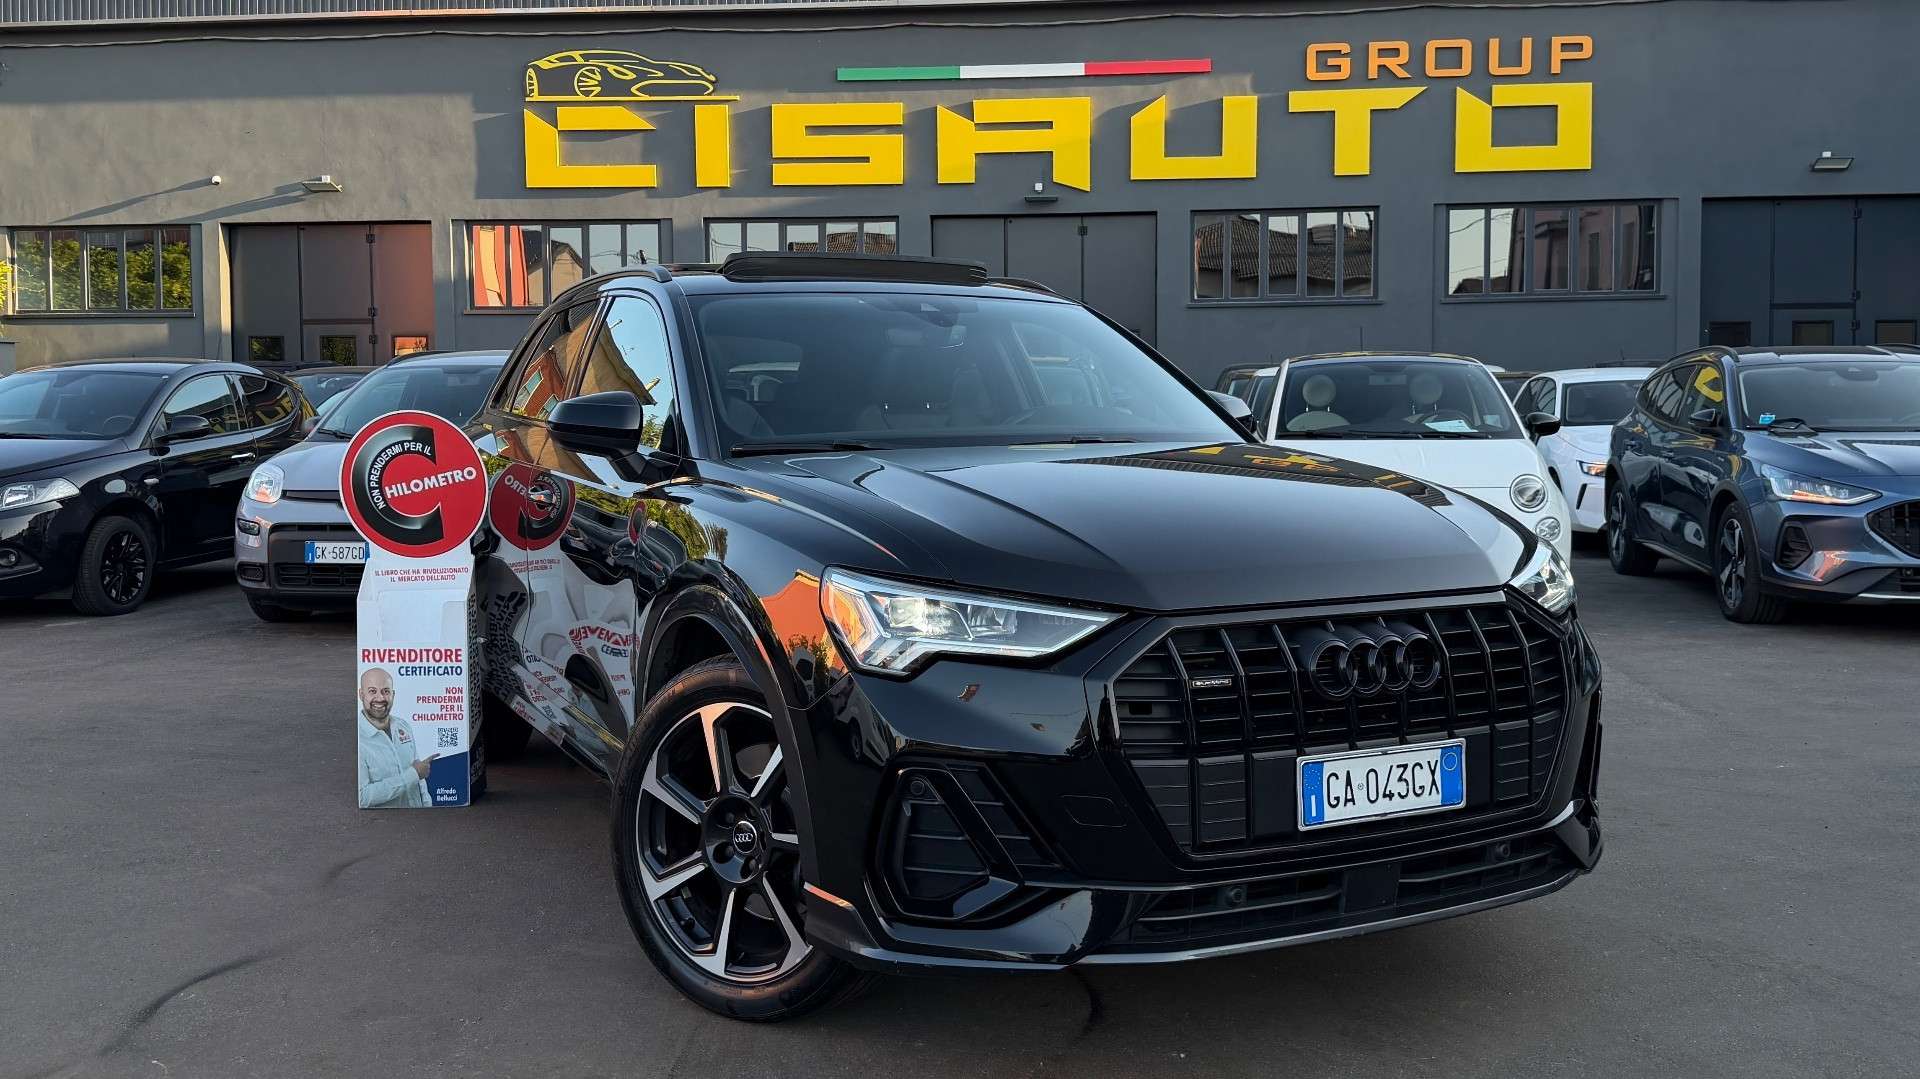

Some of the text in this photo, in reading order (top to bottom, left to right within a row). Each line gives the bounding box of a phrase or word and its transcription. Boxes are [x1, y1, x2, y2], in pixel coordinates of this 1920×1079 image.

[1306, 35, 1593, 81] GROUP
[524, 83, 1593, 192] CISAUTO
[370, 442, 432, 510] NON PRENDERMI PER IL
[361, 648, 463, 663] RIVENDITORE
[398, 665, 463, 677] CERTIFICATO
[445, 687, 464, 695] NON
[416, 695, 464, 703] PRENDERMI
[440, 704, 464, 712] PER IL
[412, 713, 464, 721] CHILOMETRO
[436, 787, 457, 795] Alfredo
